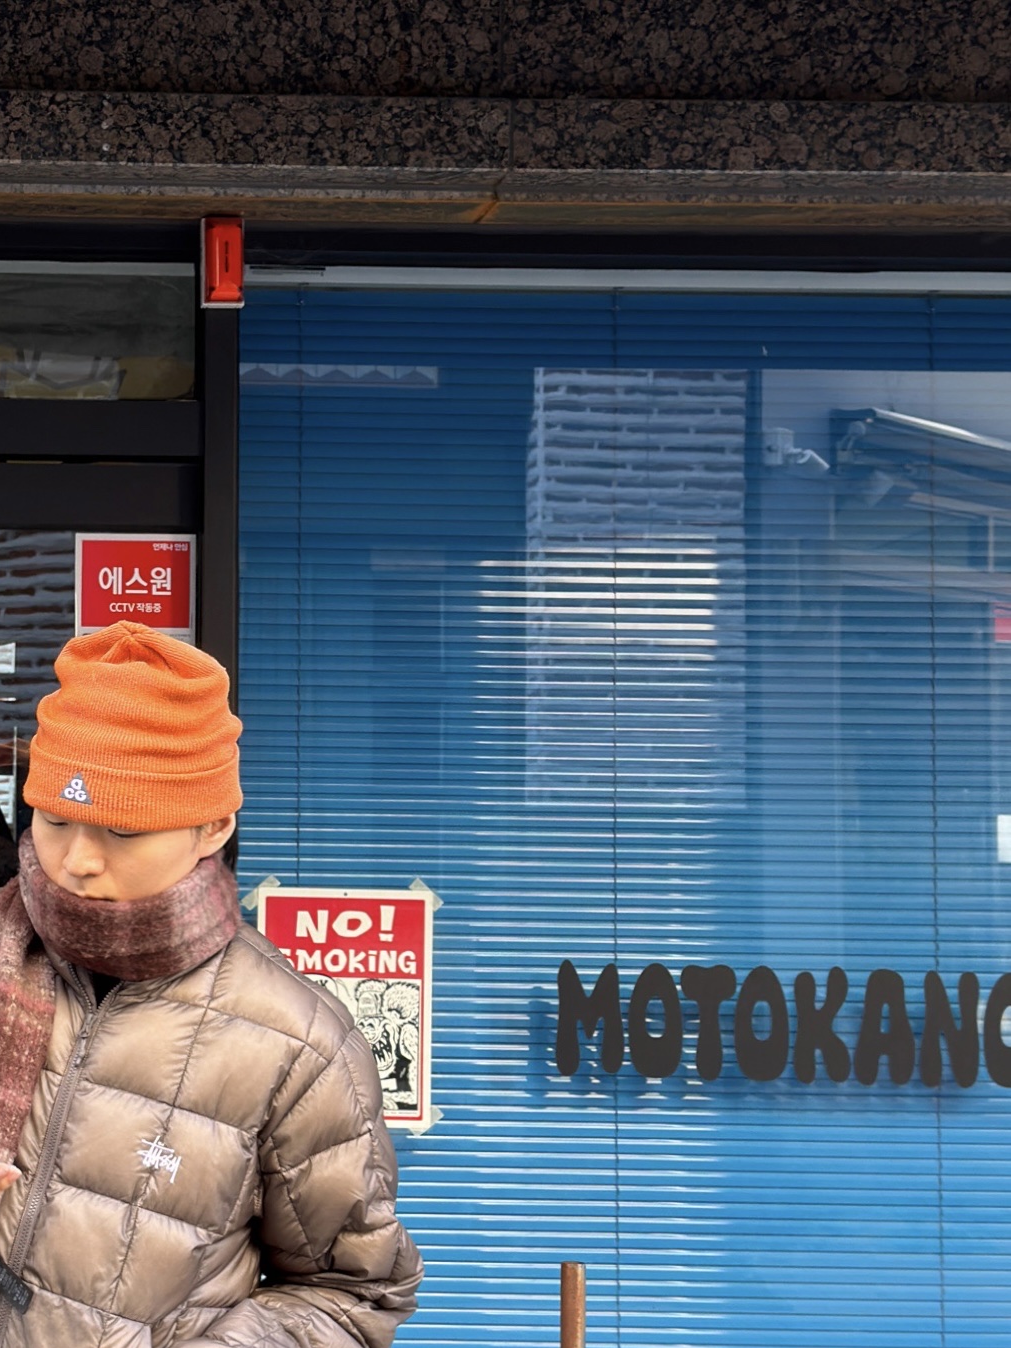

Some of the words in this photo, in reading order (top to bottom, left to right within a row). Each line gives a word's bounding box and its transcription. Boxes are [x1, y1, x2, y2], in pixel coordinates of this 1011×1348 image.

[98, 566, 172, 596] 에스원
[109, 602, 135, 612] CCTV
[136, 602, 162, 613] 작동중
[295, 905, 396, 944] NO!
